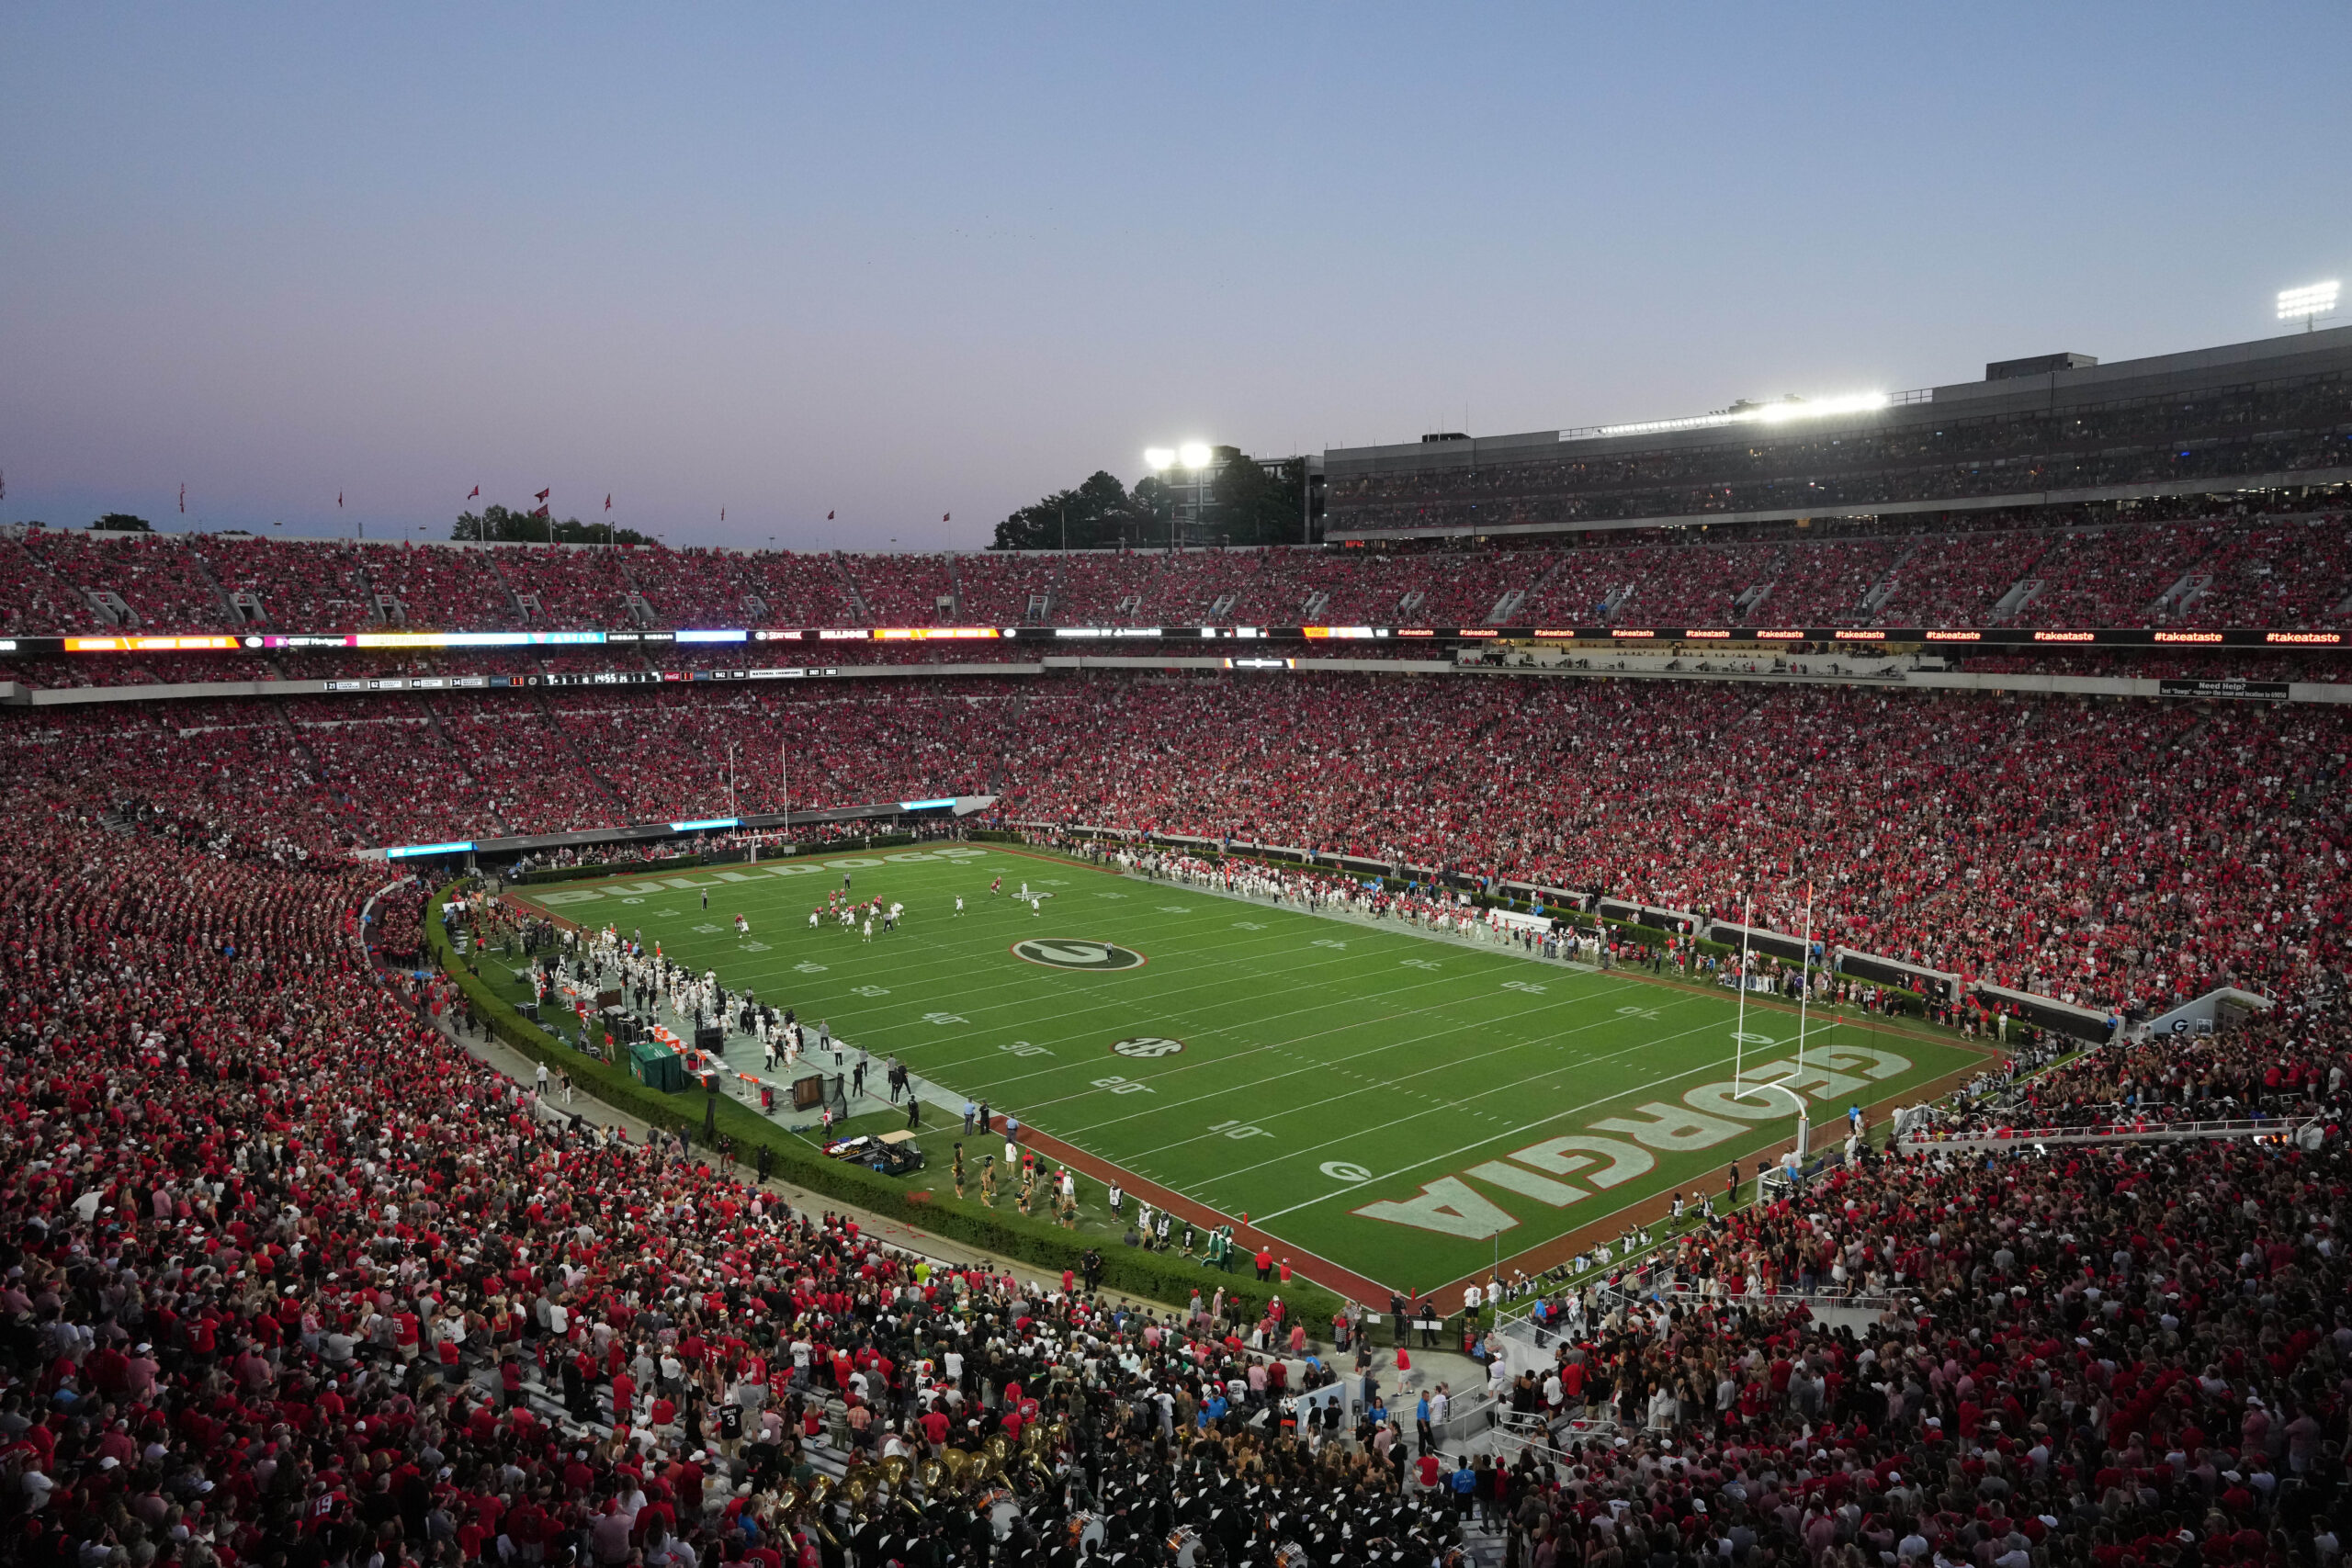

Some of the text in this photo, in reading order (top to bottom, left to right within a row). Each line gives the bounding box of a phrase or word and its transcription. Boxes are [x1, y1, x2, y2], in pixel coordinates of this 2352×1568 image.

[1460, 628, 1498, 637] #takeataste
[1757, 630, 1804, 638] #takeataste
[1836, 631, 1884, 639] #takeataste
[1926, 631, 1980, 640] #takeataste
[2035, 631, 2094, 641] #takeataste
[2154, 632, 2222, 642] #takeataste
[563, 634, 599, 642] DELTA
[2267, 633, 2340, 643] #takeataste
[594, 673, 616, 682] 14:55
[532, 847, 989, 905] BULLDOGS
[2171, 1019, 2189, 1033] G
[1090, 1076, 1148, 1094] 20
[1206, 1120, 1264, 1140] 10
[1352, 1045, 1913, 1238] GEORGIA
[1318, 1161, 1373, 1181] G
[727, 1415, 736, 1427] 3
[315, 1495, 333, 1517] 19
